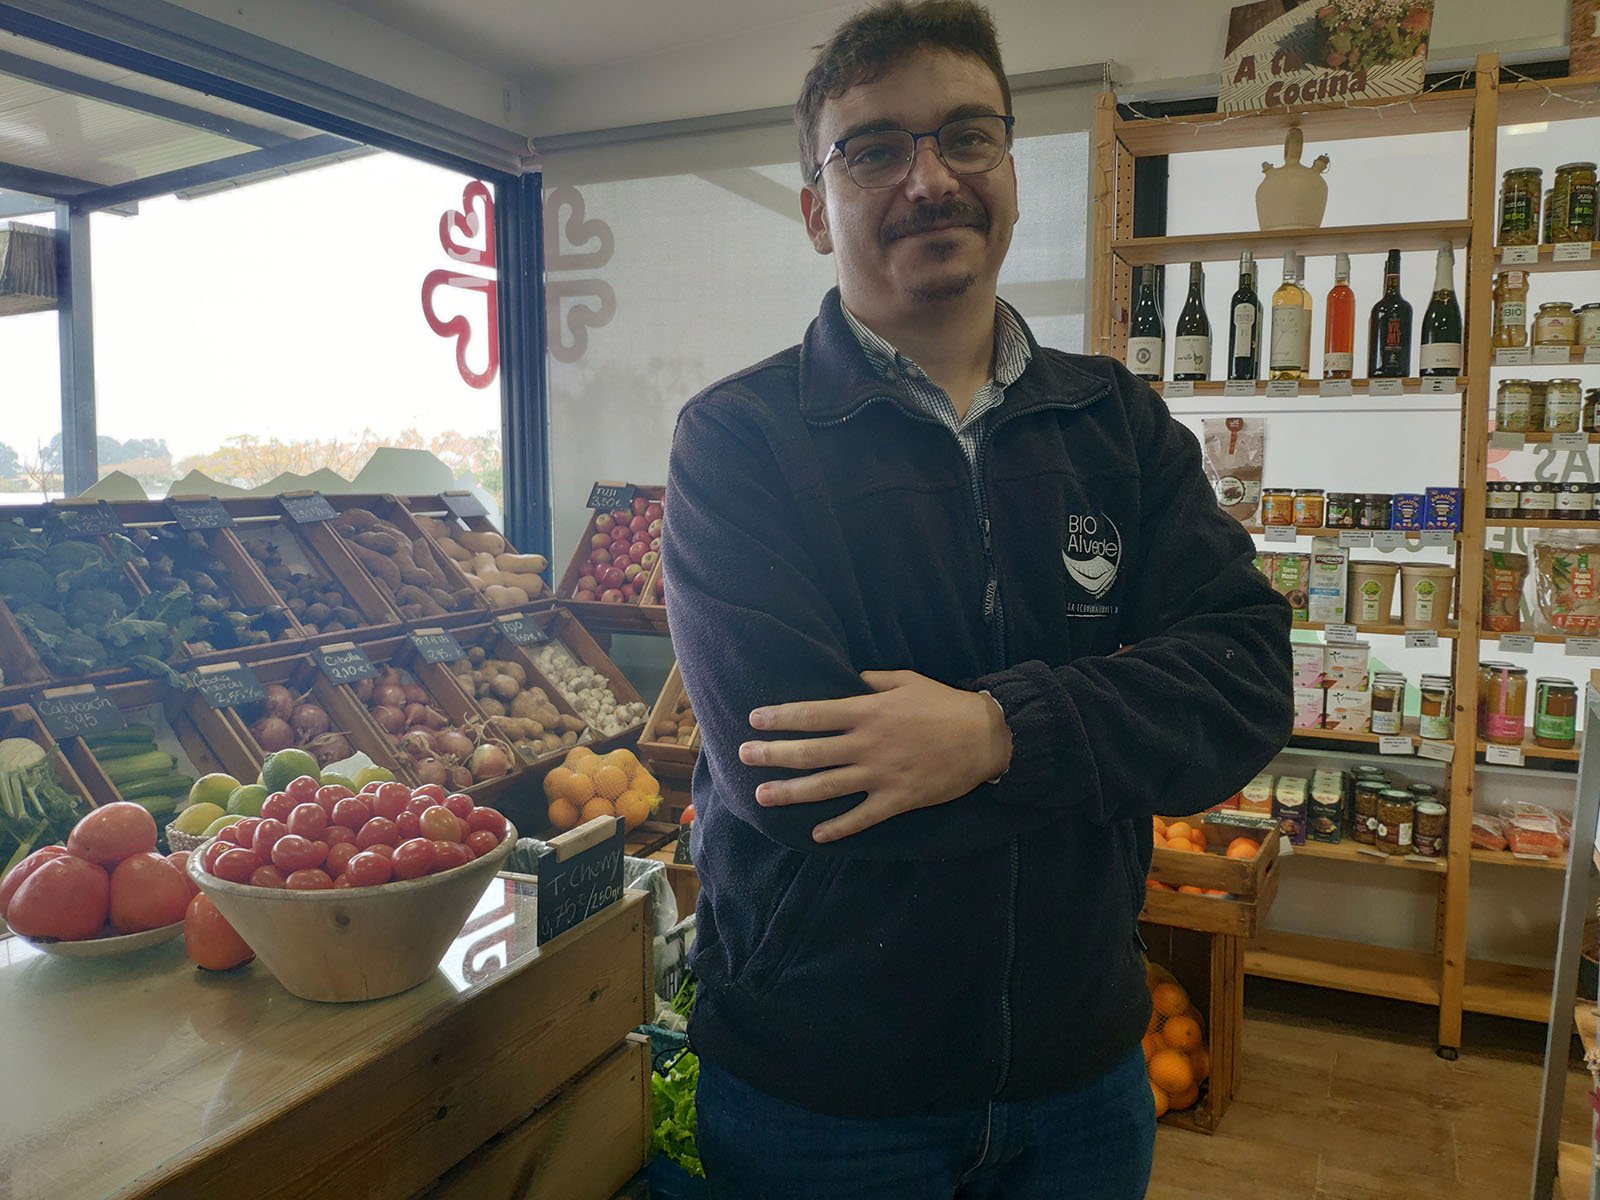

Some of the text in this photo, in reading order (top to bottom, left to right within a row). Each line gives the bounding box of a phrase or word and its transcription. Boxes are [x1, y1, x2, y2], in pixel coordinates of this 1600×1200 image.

[1233, 55, 1256, 84] A
[1265, 71, 1367, 107] Cocina
[1503, 308, 1522, 317] BIO
[1068, 514, 1097, 535] BIO
[1067, 533, 1118, 557] Alvede
[569, 848, 621, 888] Cherry
